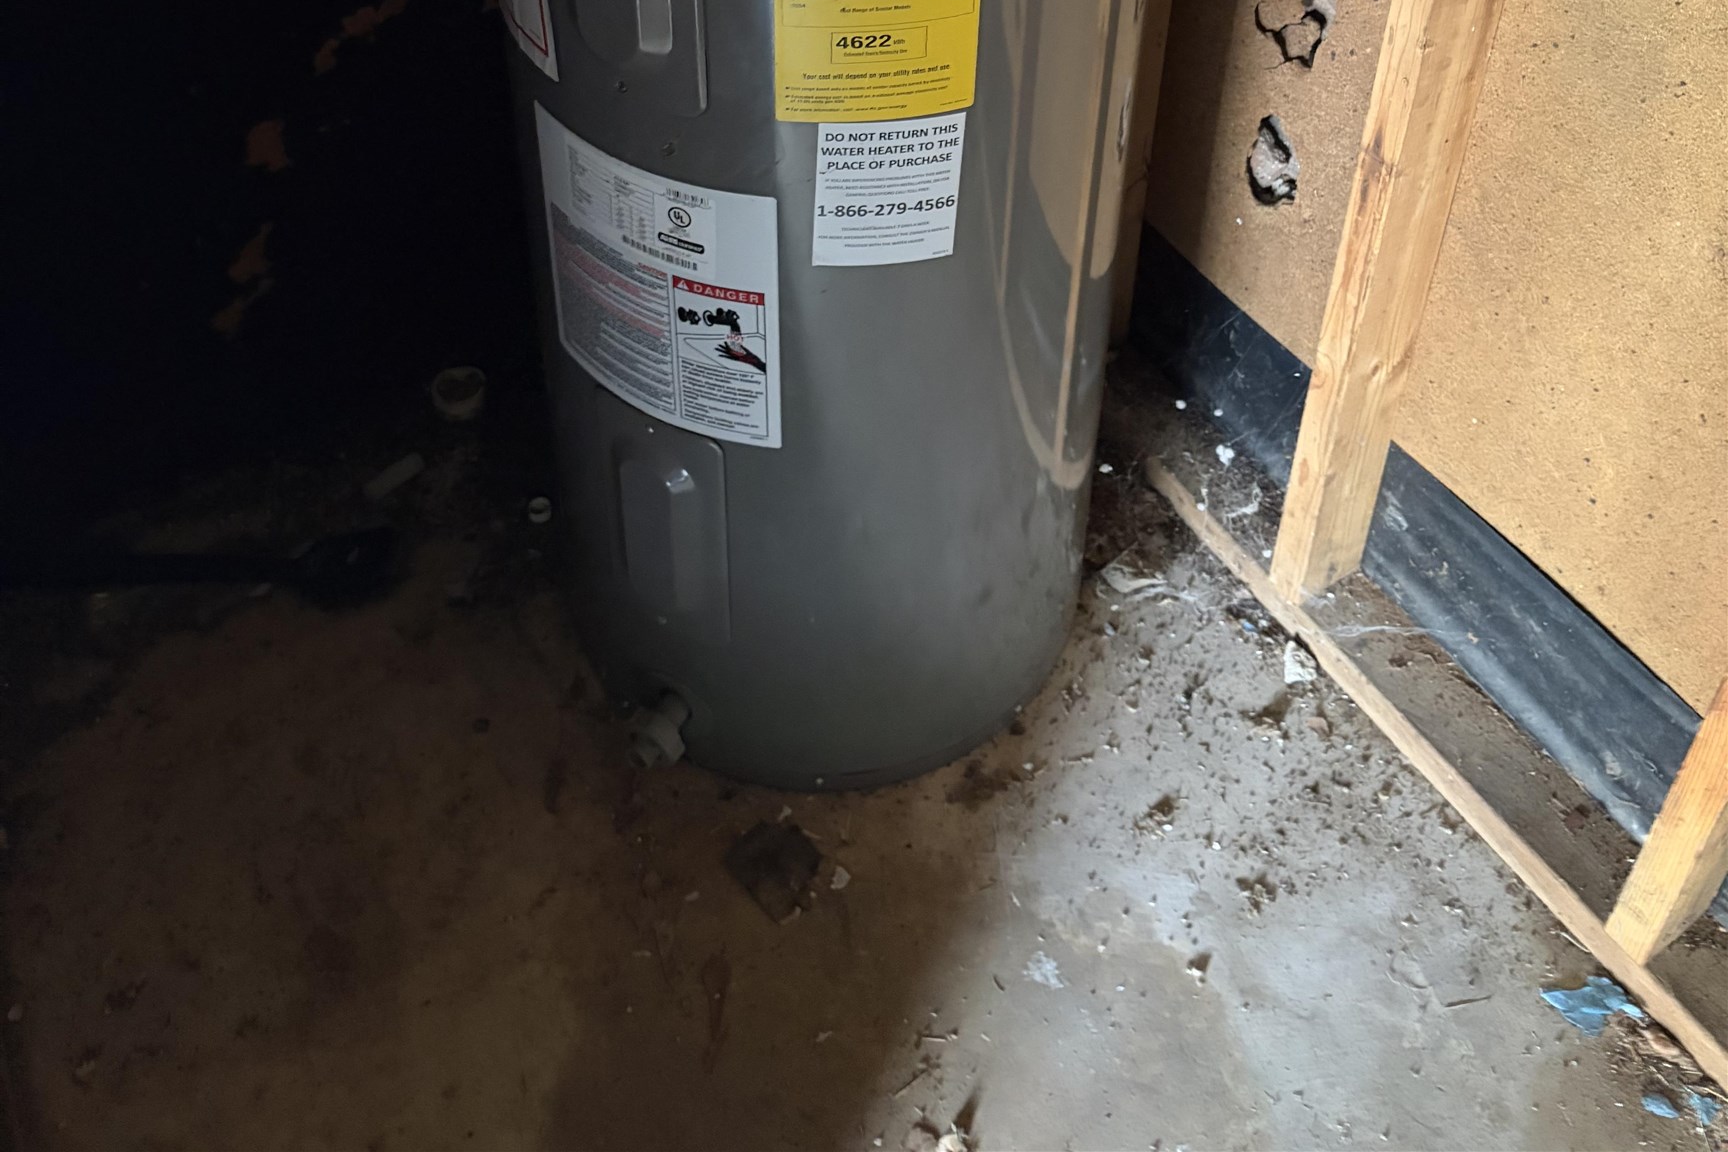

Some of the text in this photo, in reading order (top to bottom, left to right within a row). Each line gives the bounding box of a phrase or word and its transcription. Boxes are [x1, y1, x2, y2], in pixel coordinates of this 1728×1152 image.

[835, 34, 892, 49] 4622
[802, 72, 817, 80] Your
[818, 72, 831, 80] cost
[833, 72, 844, 80] will
[845, 71, 868, 80] depend
[878, 71, 892, 80] your
[893, 69, 910, 79] utility
[824, 123, 959, 143] DO NOT RETURN THIS
[821, 137, 960, 156] WATER HEATER TO THE
[827, 152, 953, 171] PLACE OF PURCHASE
[817, 194, 955, 217] 1-866-279-4566
[693, 283, 760, 304] DANGER
